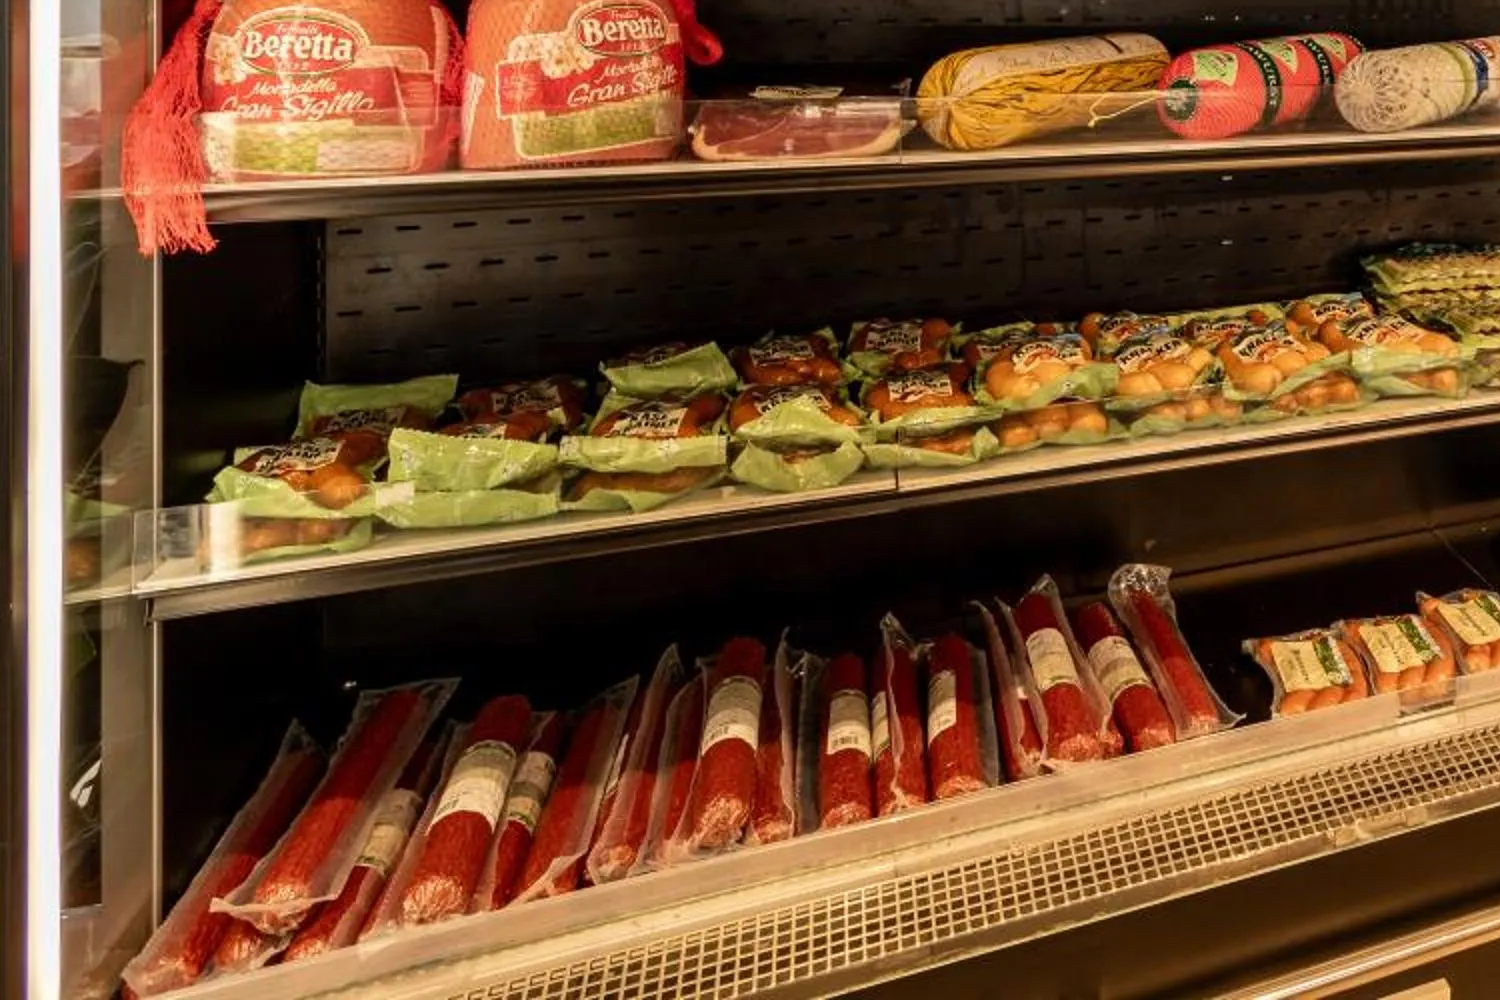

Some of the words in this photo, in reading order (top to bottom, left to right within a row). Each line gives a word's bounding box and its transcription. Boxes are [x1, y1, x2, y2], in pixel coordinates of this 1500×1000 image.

[580, 13, 666, 47] Beretta
[244, 31, 353, 61] Beretta
[220, 96, 274, 119] Gran
[279, 91, 375, 121] Sigillo
[567, 83, 626, 107] Gran
